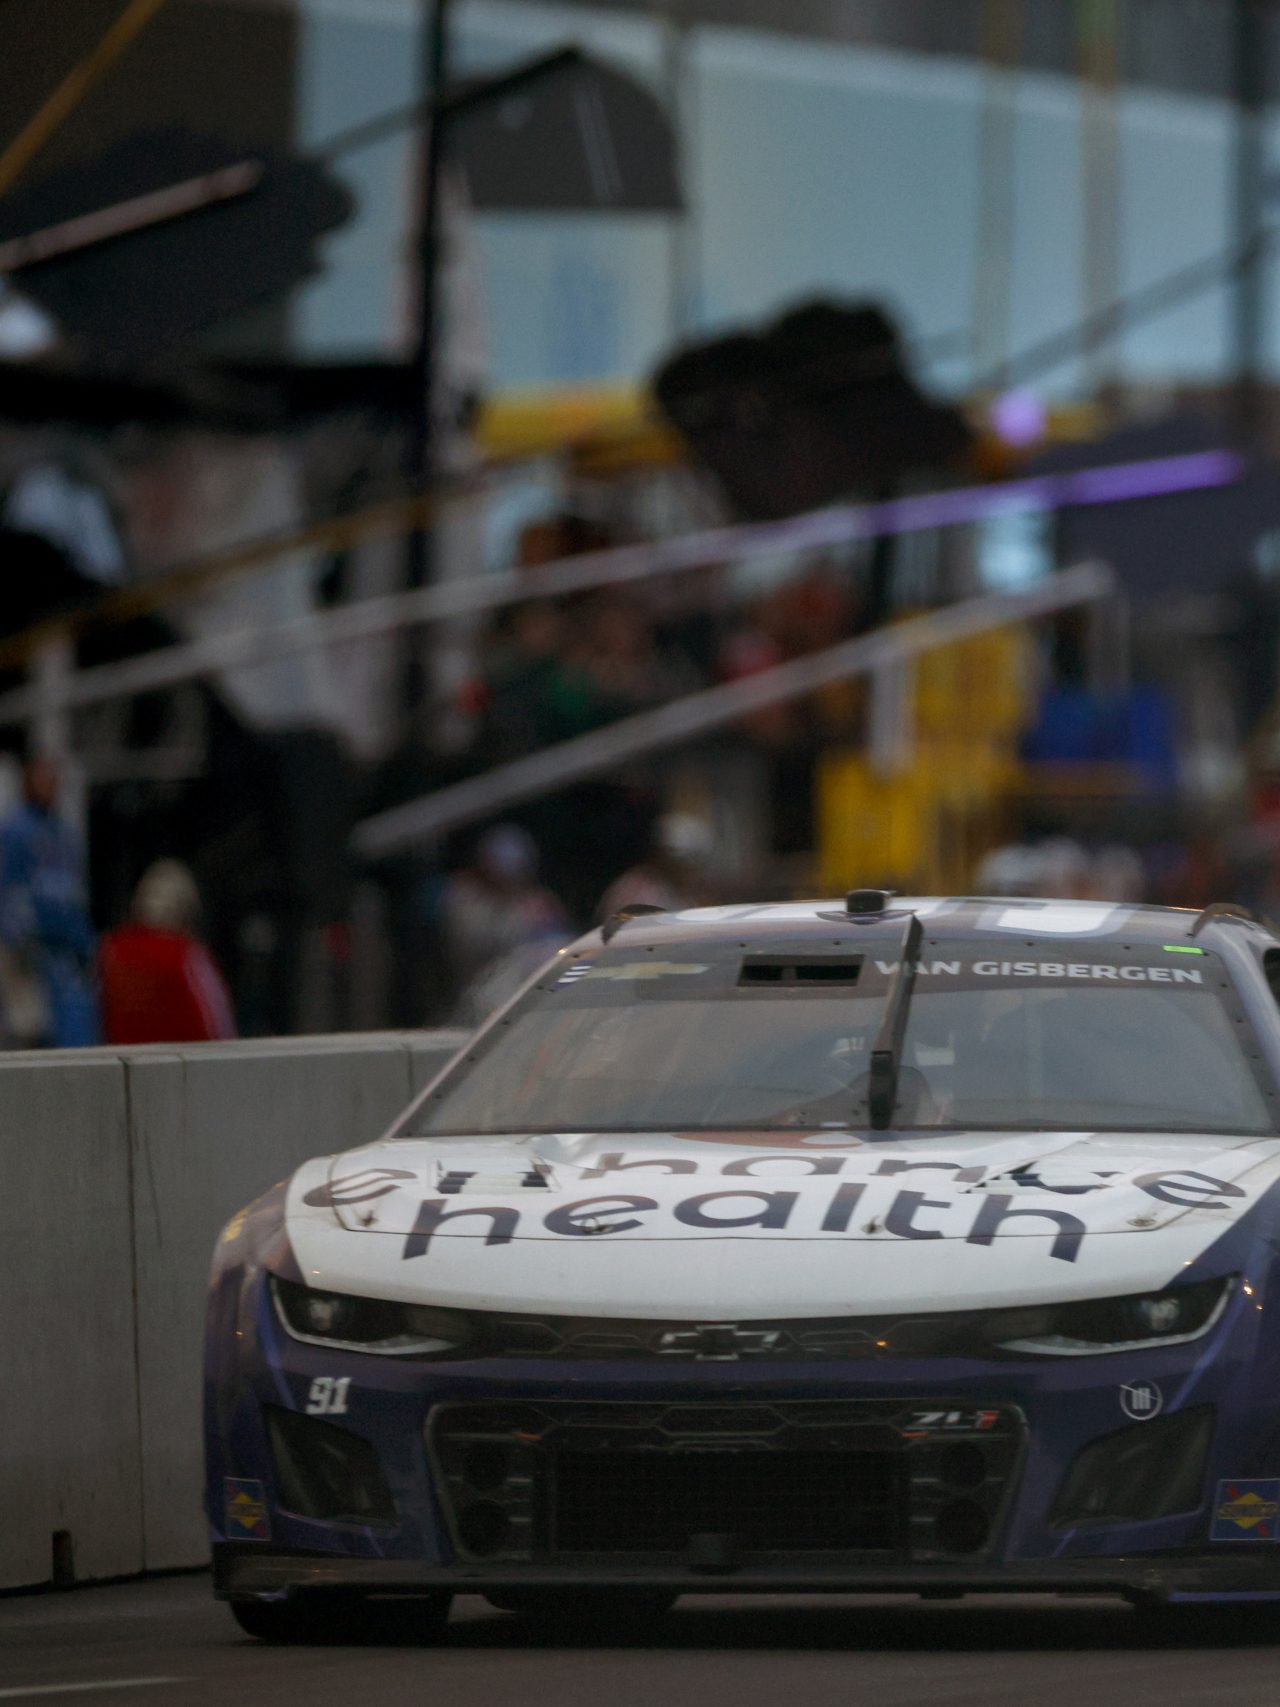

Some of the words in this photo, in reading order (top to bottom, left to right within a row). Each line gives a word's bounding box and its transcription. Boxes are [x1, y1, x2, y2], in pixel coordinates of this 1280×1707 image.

[873, 960, 961, 975] VAN
[971, 960, 1204, 984] GISBERGEN
[403, 1182, 1087, 1264] health
[305, 1376, 354, 1415] 91
